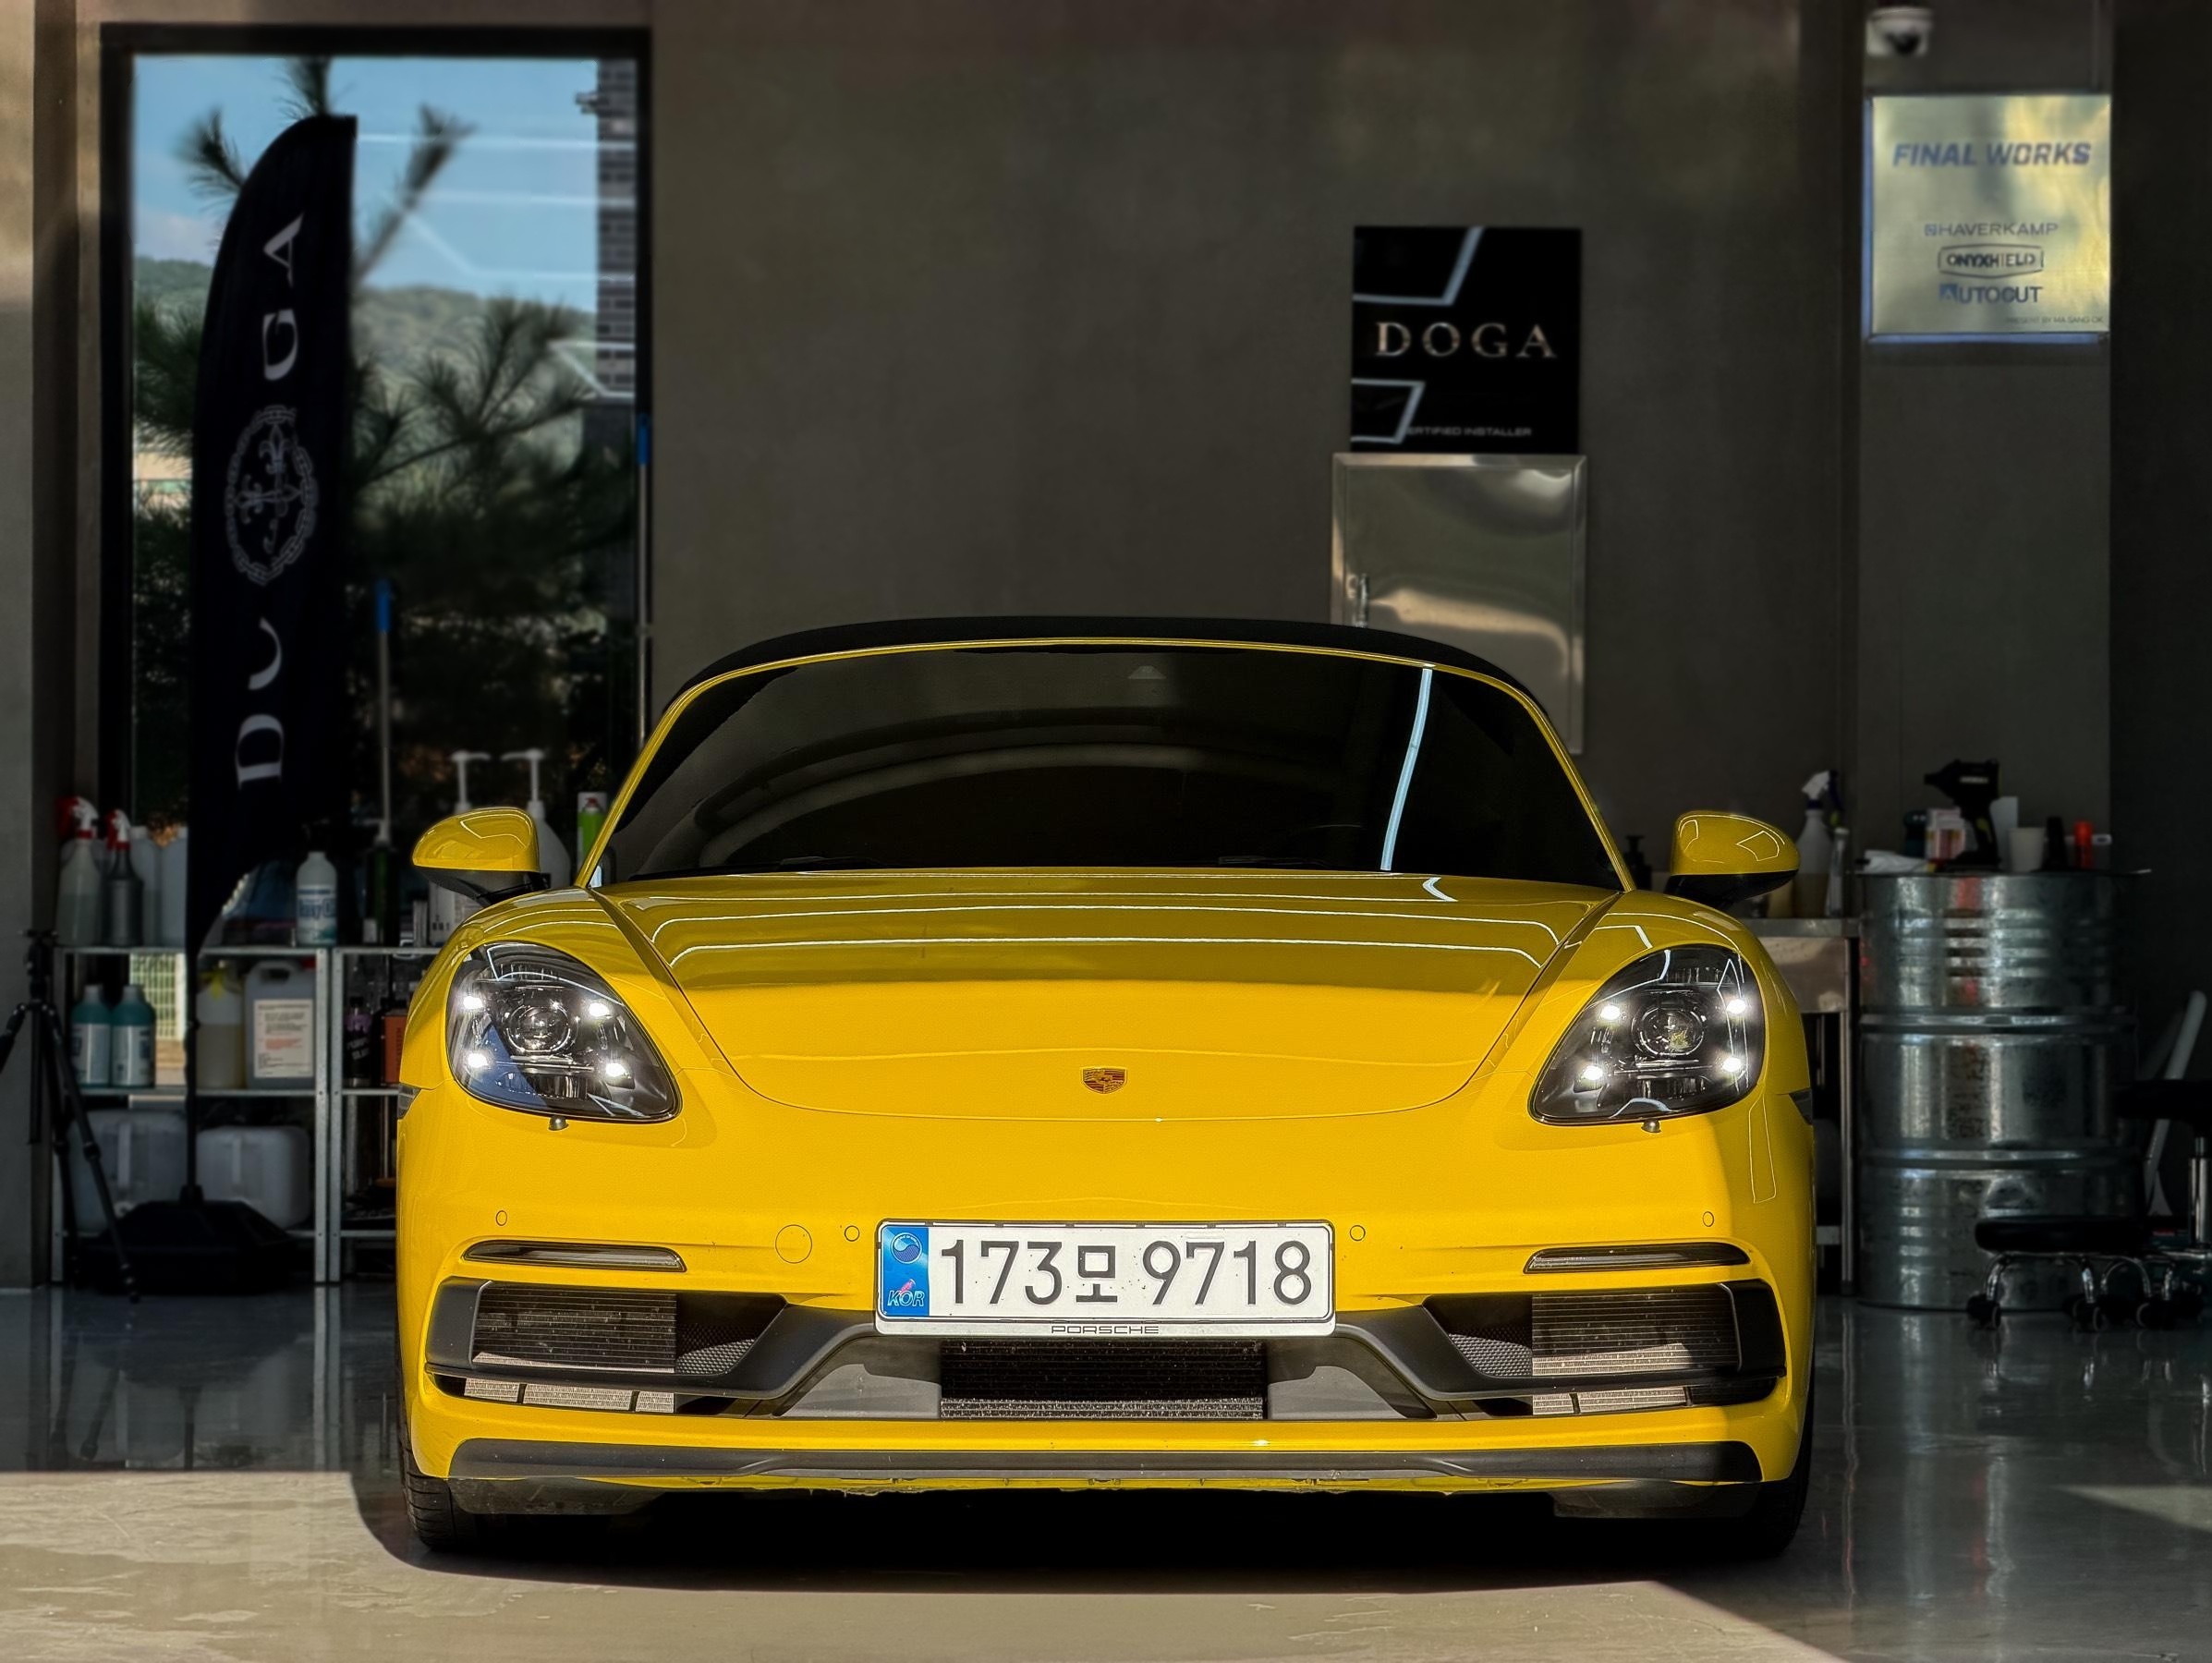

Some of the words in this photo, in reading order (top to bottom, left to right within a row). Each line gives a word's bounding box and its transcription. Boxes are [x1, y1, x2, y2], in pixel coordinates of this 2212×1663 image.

[1892, 143, 1977, 167] FINAL
[1987, 142, 2092, 165] WORKS
[1375, 322, 1558, 358] DOGA
[1404, 426, 1462, 436] ERTIFIED
[1464, 426, 1533, 437] INSTALLER
[941, 1239, 1118, 1306] 173모
[1142, 1239, 1312, 1306] 9718
[887, 1290, 925, 1307] KOR
[1051, 1325, 1160, 1335] PORSCHE
